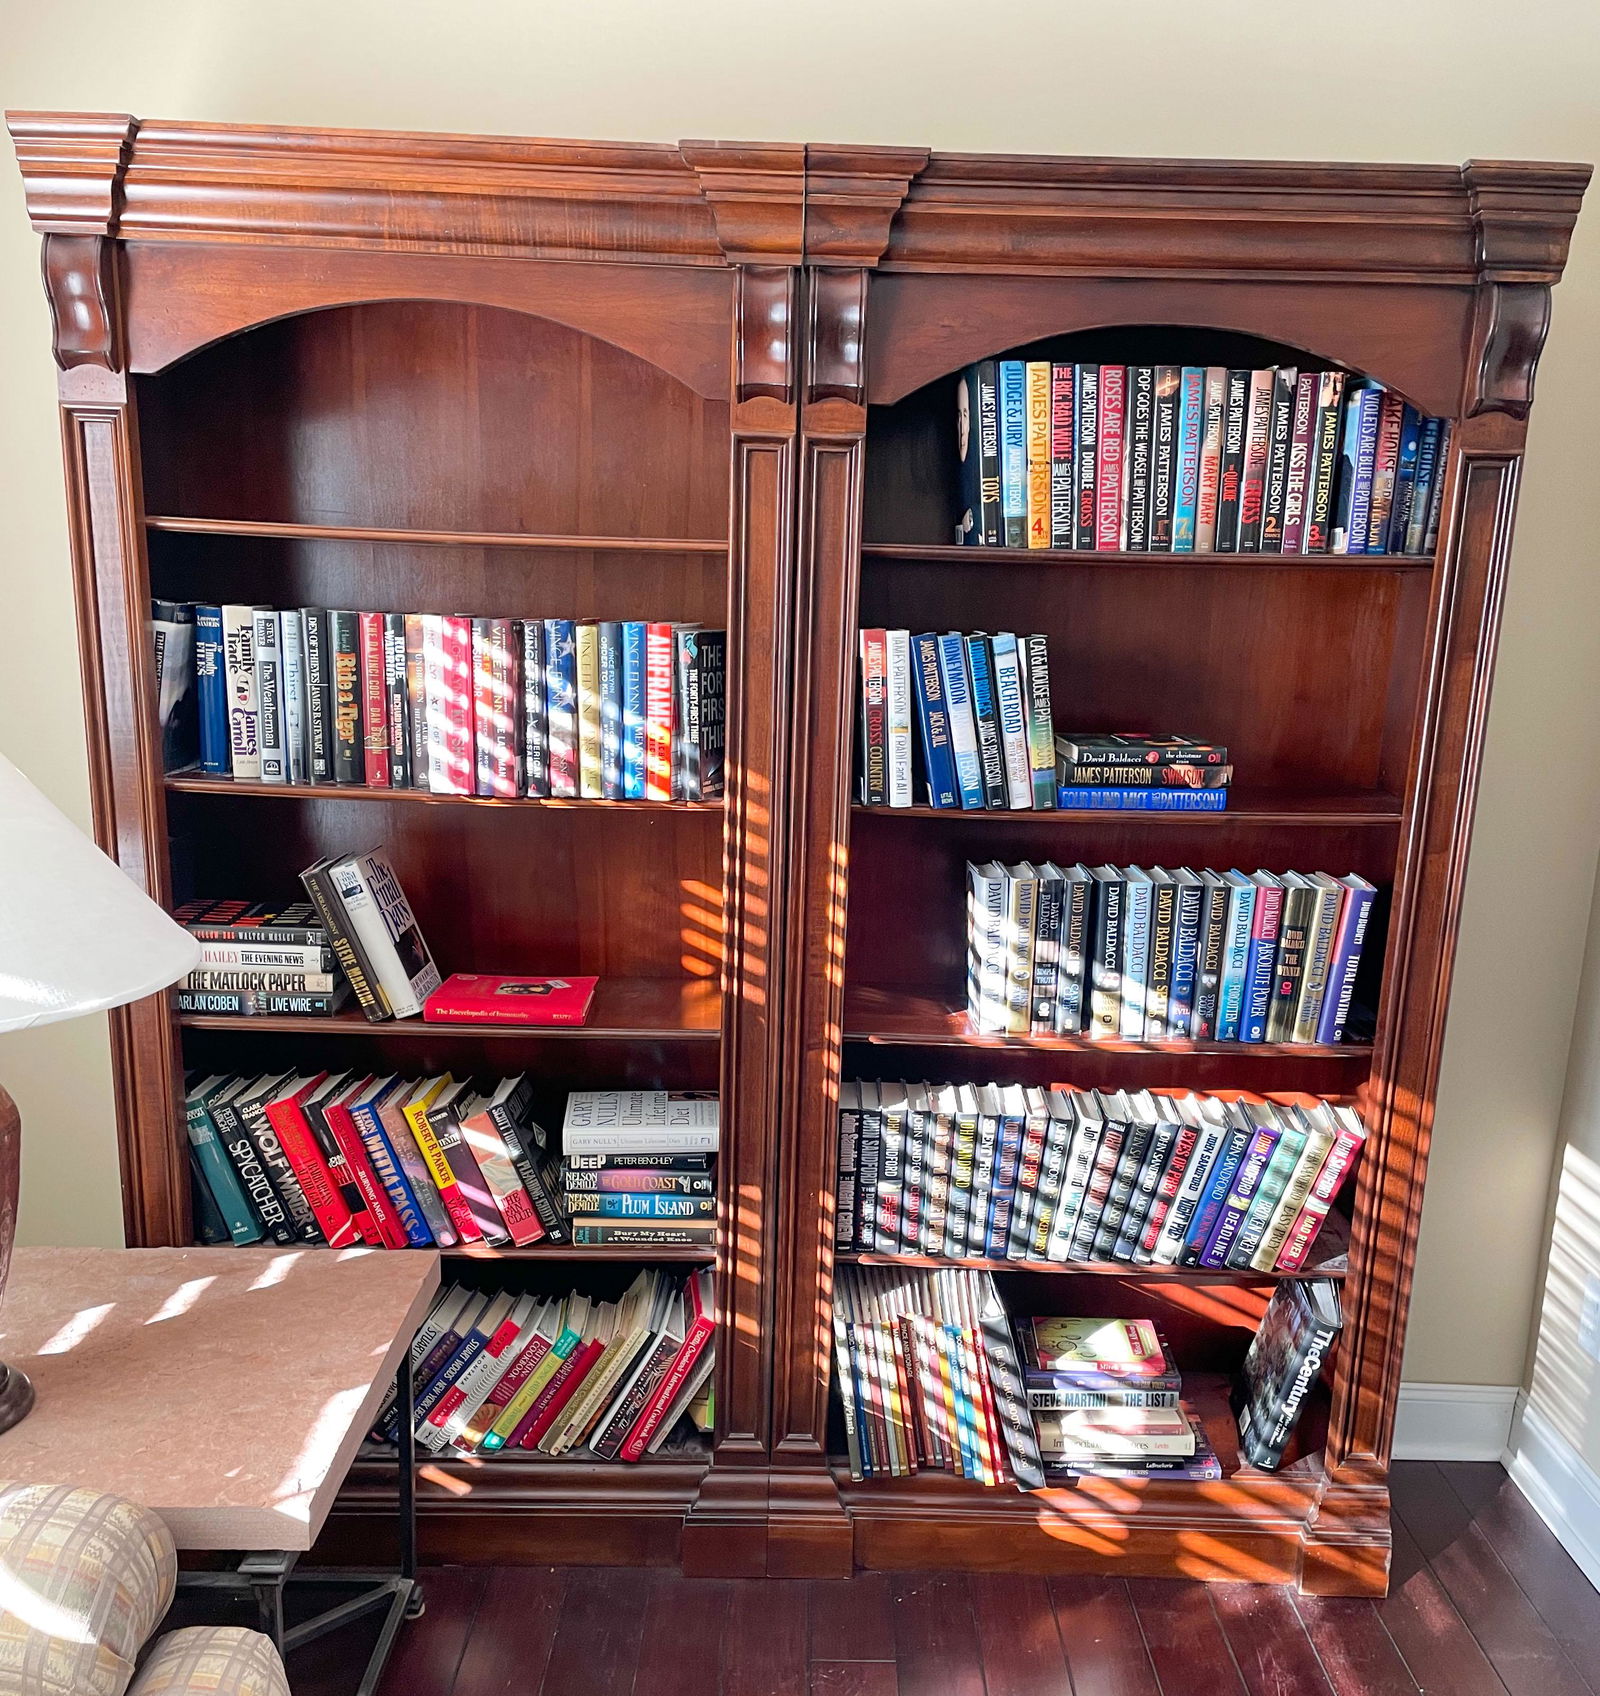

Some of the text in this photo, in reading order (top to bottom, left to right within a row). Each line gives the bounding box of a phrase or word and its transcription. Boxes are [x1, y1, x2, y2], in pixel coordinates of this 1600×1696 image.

[1103, 370, 1123, 460] ROSES ARE RED
[1133, 368, 1150, 478] POP GOES THE WEASEL
[1295, 378, 1312, 436] PATTERSON
[1156, 403, 1172, 516] JAMES PATTERSON
[1314, 410, 1337, 522] JAMES PATTERSON
[1360, 393, 1380, 483] VIOLETS ARE BLUE
[982, 475, 1000, 503] TOYS
[1081, 451, 1095, 527] DOUBLE CROSS
[1200, 455, 1216, 525] MARY MARY
[1223, 471, 1238, 501] QUICKIE
[1285, 442, 1307, 526] KISS THE GIRLS
[1130, 487, 1145, 543] PATTERSON
[1351, 490, 1370, 550] PATTERSON
[227, 628, 244, 677] Trade
[239, 624, 256, 677] Family
[257, 619, 267, 647] THAYER
[266, 622, 276, 645] STEVE
[384, 628, 406, 686] ROGUE WARRIOR
[335, 652, 359, 744] Ride a Tiger
[414, 652, 425, 704] UNBROKEN
[647, 634, 672, 728] AIRFRAME
[943, 638, 967, 705] HONEYMOON
[969, 640, 993, 718] LONDON BRIDGES
[999, 666, 1022, 733] BEACH ROAD
[232, 707, 248, 756] Carroll
[244, 708, 258, 756] James
[263, 663, 279, 747] The Weatherman
[369, 706, 381, 724] DAN
[525, 732, 534, 778] ASSASSIN
[532, 731, 542, 779] AMERICAN
[634, 726, 647, 782] MEMORIAL
[869, 709, 884, 793] CROSS COUNTRY
[979, 720, 1002, 787] JAMES PATTERSON
[1071, 766, 1153, 785] JAMES PATTERSON
[1082, 751, 1142, 764] David Baldacci
[1162, 768, 1206, 785] SWIMSUIT
[1165, 750, 1202, 760] the christmas
[1161, 793, 1220, 810] PATTERSON
[1039, 893, 1060, 938] DAVID BALDACCI
[1104, 886, 1120, 969] DAVID BALDACCI
[1153, 889, 1173, 980] DAVID BALDACCI
[1176, 889, 1198, 982] DAVID BALDACCI
[1205, 890, 1224, 969] DAVID BALDACCI
[1232, 891, 1251, 968] DAVID BALDACCI
[1311, 893, 1337, 977] DAVID BALDACCI
[187, 971, 306, 992] THE MATLOCK PAPER
[203, 950, 239, 963] HAILEY
[241, 953, 304, 965] THE EVENING NEWS
[333, 937, 376, 1008] STEVE MARTINI
[208, 996, 239, 1011] COBEN
[270, 997, 312, 1012] LIVE WIRE
[1198, 993, 1215, 1017] STONE COLD
[1225, 983, 1240, 1022] FORGOTTEN
[1334, 954, 1360, 1026] TOTAL CONTROL
[622, 1090, 690, 1127] Ultimate Lifetime Diet
[249, 1114, 290, 1170] WOLF
[272, 1168, 314, 1227] WINTER
[570, 1154, 606, 1169] DEEP
[614, 1156, 674, 1166] PETER BENCHLEY
[860, 1114, 881, 1184] JOHN SANDFORD
[910, 1113, 924, 1185] JOHN SANDFORD
[1021, 1119, 1044, 1188] RULES OF PREY
[1160, 1128, 1196, 1197] EYES OF PREY
[1210, 1130, 1247, 1202] JOHN SANDFORD
[228, 1139, 285, 1228] SPYCATCHER
[304, 1157, 335, 1207] BARBARIANS
[357, 1170, 387, 1224] BURNING ANGEL
[565, 1171, 598, 1191] NELSON DEMILLE
[611, 1174, 679, 1192] GOLD COAST
[621, 1194, 695, 1216] PLUM ISLAND
[1210, 1131, 1274, 1259] JOHN SANDFORD DEADLINE
[907, 1185, 920, 1242] CERTAIN PREY
[1165, 1195, 1196, 1243] NIGHT PREY
[1236, 1197, 1273, 1256] BROKEN PREY
[1287, 1214, 1316, 1259] MAD RIVER
[420, 1337, 479, 1409] STUART WOODS NEW YORK
[506, 1337, 541, 1382] COOKBOOK
[520, 1343, 547, 1377] PRITIKIN
[637, 1326, 706, 1440] Betty Crocker's International Cookbook
[993, 1349, 1022, 1434] BLACK JACK BOOTS
[1032, 1392, 1106, 1408] STEVE MARTINI
[1124, 1391, 1168, 1408] THE LIST
